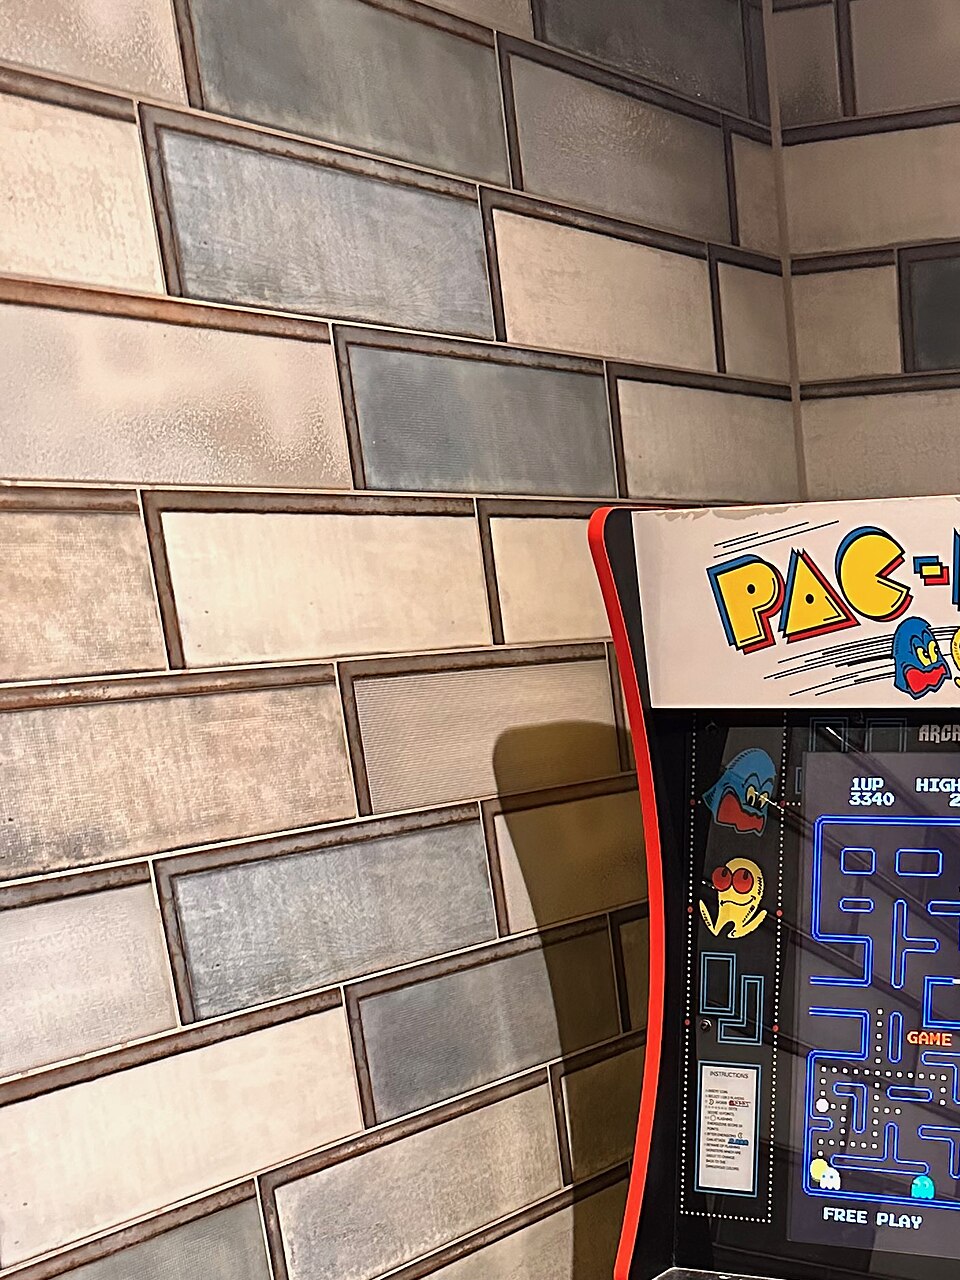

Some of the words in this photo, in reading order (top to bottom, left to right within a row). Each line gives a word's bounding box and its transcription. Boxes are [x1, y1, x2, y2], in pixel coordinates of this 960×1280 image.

[850, 777, 884, 791] 1UP
[849, 791, 895, 806] 3340
[906, 1031, 953, 1047] GAME
[709, 1070, 749, 1079] INSTRUCTIONS
[823, 1206, 868, 1224] FREE
[876, 1212, 922, 1229] PLAY
